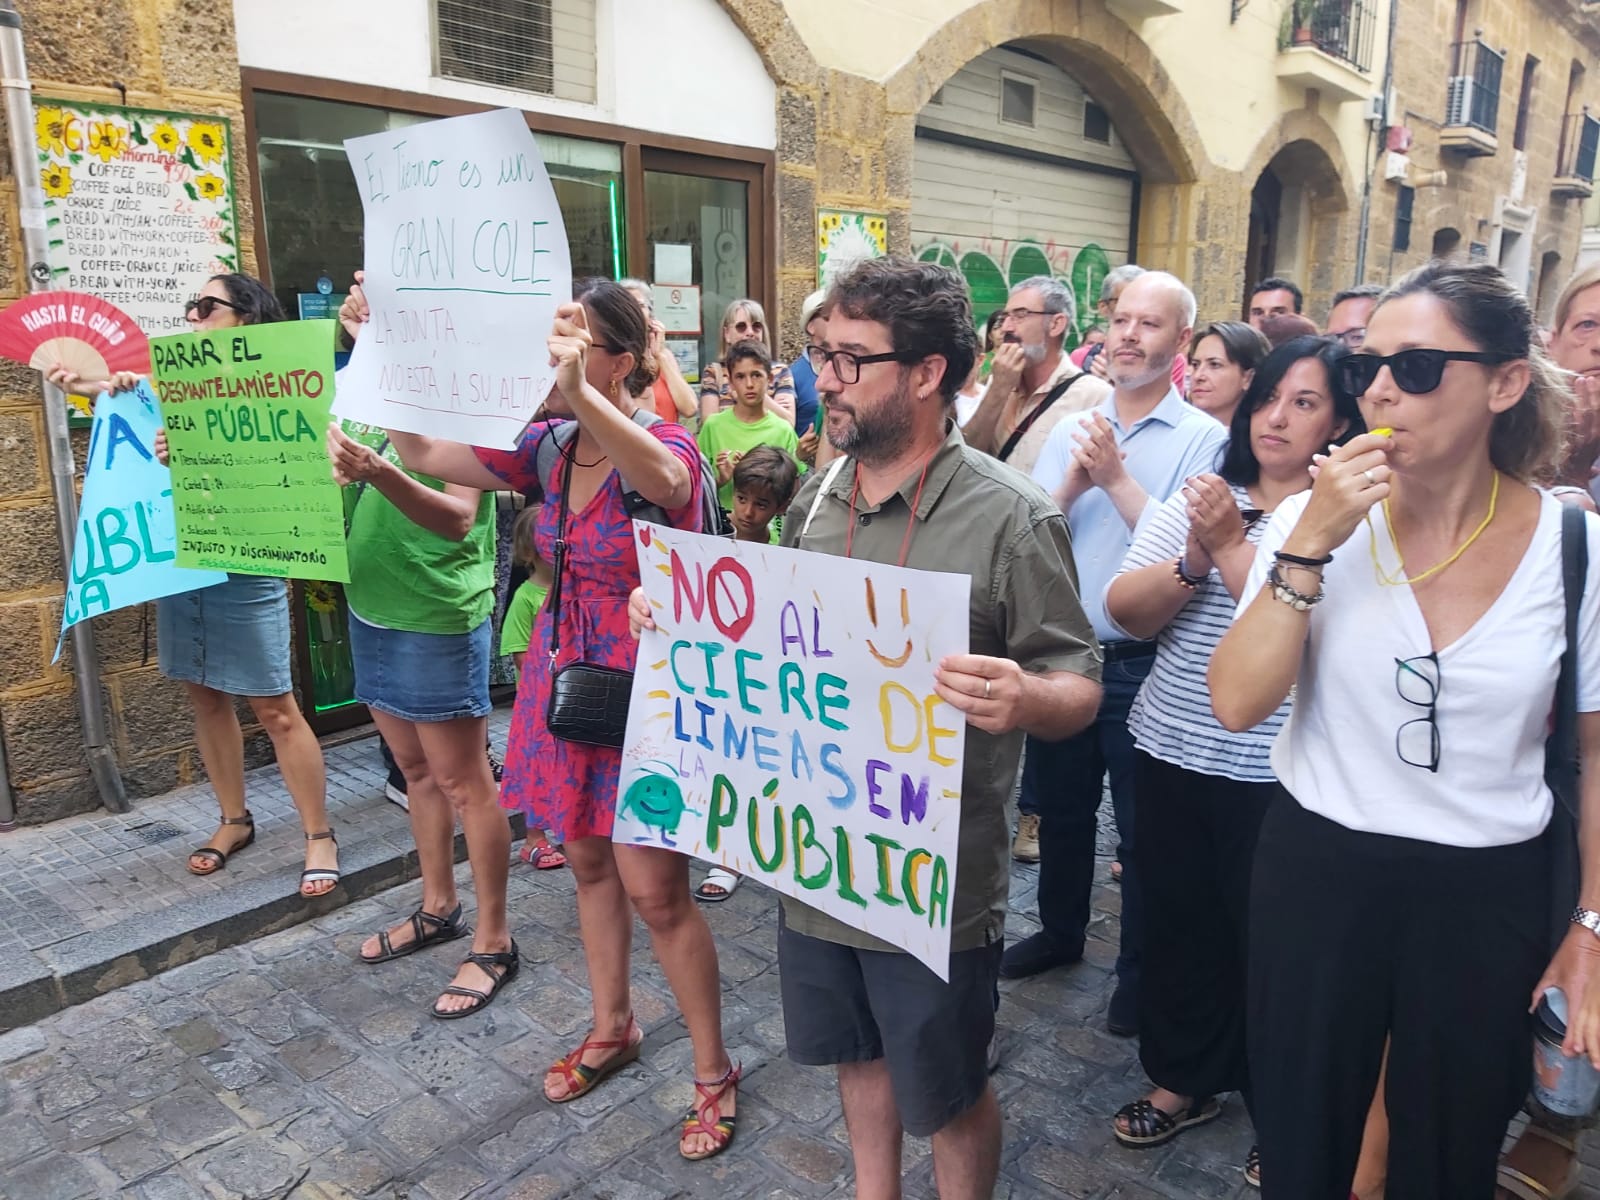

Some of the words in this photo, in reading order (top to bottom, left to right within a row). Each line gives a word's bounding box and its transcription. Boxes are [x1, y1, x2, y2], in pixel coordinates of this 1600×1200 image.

[88, 162, 135, 179] COFFEE
[459, 160, 481, 188] es
[498, 153, 534, 187] un
[73, 179, 109, 194] COFFEE
[113, 182, 133, 194] and
[136, 181, 170, 199] BREAD
[64, 210, 99, 225] BREAD
[66, 226, 105, 241] BREAD
[68, 242, 106, 257] BREAD
[391, 217, 455, 281] GRAN
[473, 219, 551, 284] COLE
[69, 274, 110, 288] BREAD
[21, 304, 68, 332] HASTA
[71, 305, 86, 326] EL
[88, 311, 126, 346] COÑO
[396, 307, 458, 344] JUNTA
[154, 338, 222, 375] PARAR
[232, 336, 262, 363] EL
[157, 369, 324, 404] DESMANTELAMIENTO
[378, 363, 402, 391] NO
[450, 373, 461, 410] A
[469, 373, 491, 403] SU
[205, 402, 317, 443] PÚBLICA
[183, 540, 226, 555] INJUSTO
[230, 544, 237, 557] Y
[240, 542, 327, 565] DISCRIMINATORIO
[671, 549, 755, 643] NO
[780, 600, 833, 658] AL
[670, 640, 850, 731] CIERE
[880, 681, 958, 767] DE
[674, 697, 857, 809] LINEAS
[865, 759, 929, 825] EN
[679, 748, 707, 782] LA
[706, 773, 948, 928] PÚBLICA
